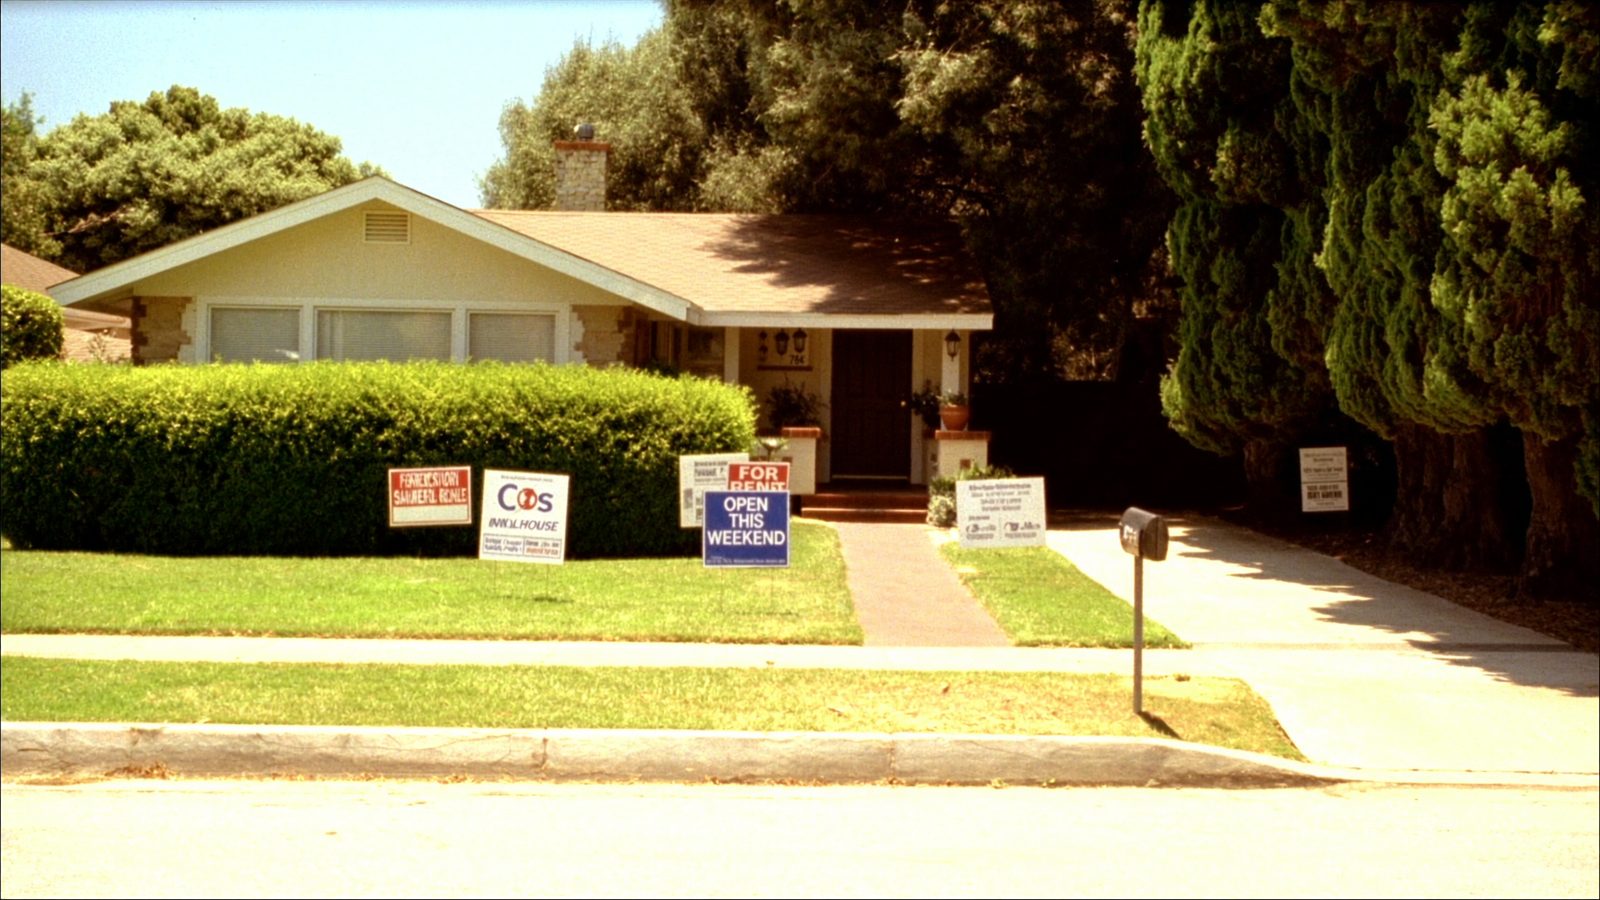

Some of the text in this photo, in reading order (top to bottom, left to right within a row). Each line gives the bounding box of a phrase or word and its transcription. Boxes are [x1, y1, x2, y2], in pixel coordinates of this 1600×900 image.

[739, 465, 778, 481] FOR
[723, 496, 769, 512] OPEN
[728, 513, 764, 528] THIS
[707, 530, 786, 546] WEEKEND
